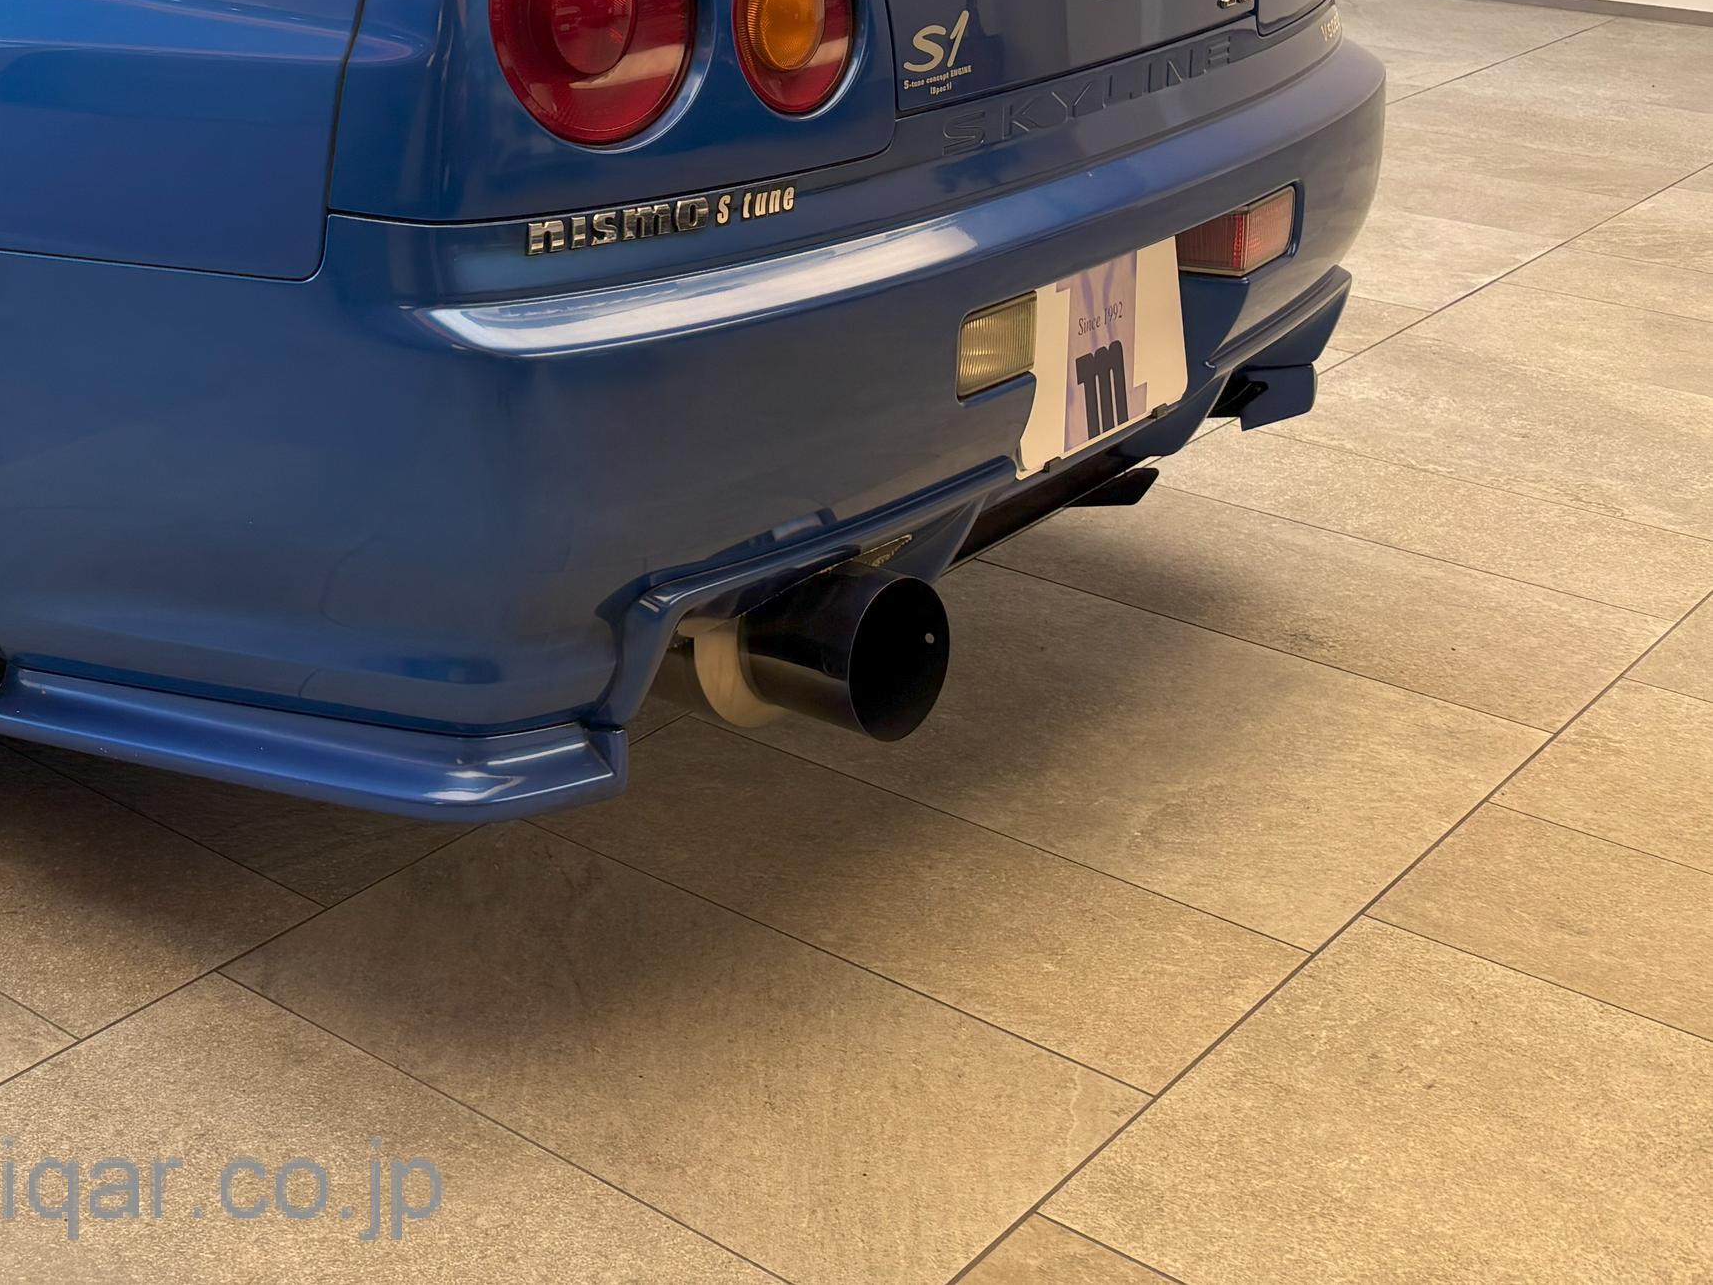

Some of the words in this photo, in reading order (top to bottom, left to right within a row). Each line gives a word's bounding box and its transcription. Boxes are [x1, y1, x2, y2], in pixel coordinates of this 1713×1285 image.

[903, 10, 970, 73] S1
[926, 72, 949, 82] concept
[950, 64, 972, 77] ENGINE
[942, 35, 1232, 155] SKYLINE
[742, 185, 795, 219] tune
[1077, 316, 1101, 337] Since
[1103, 301, 1124, 326] 1992
